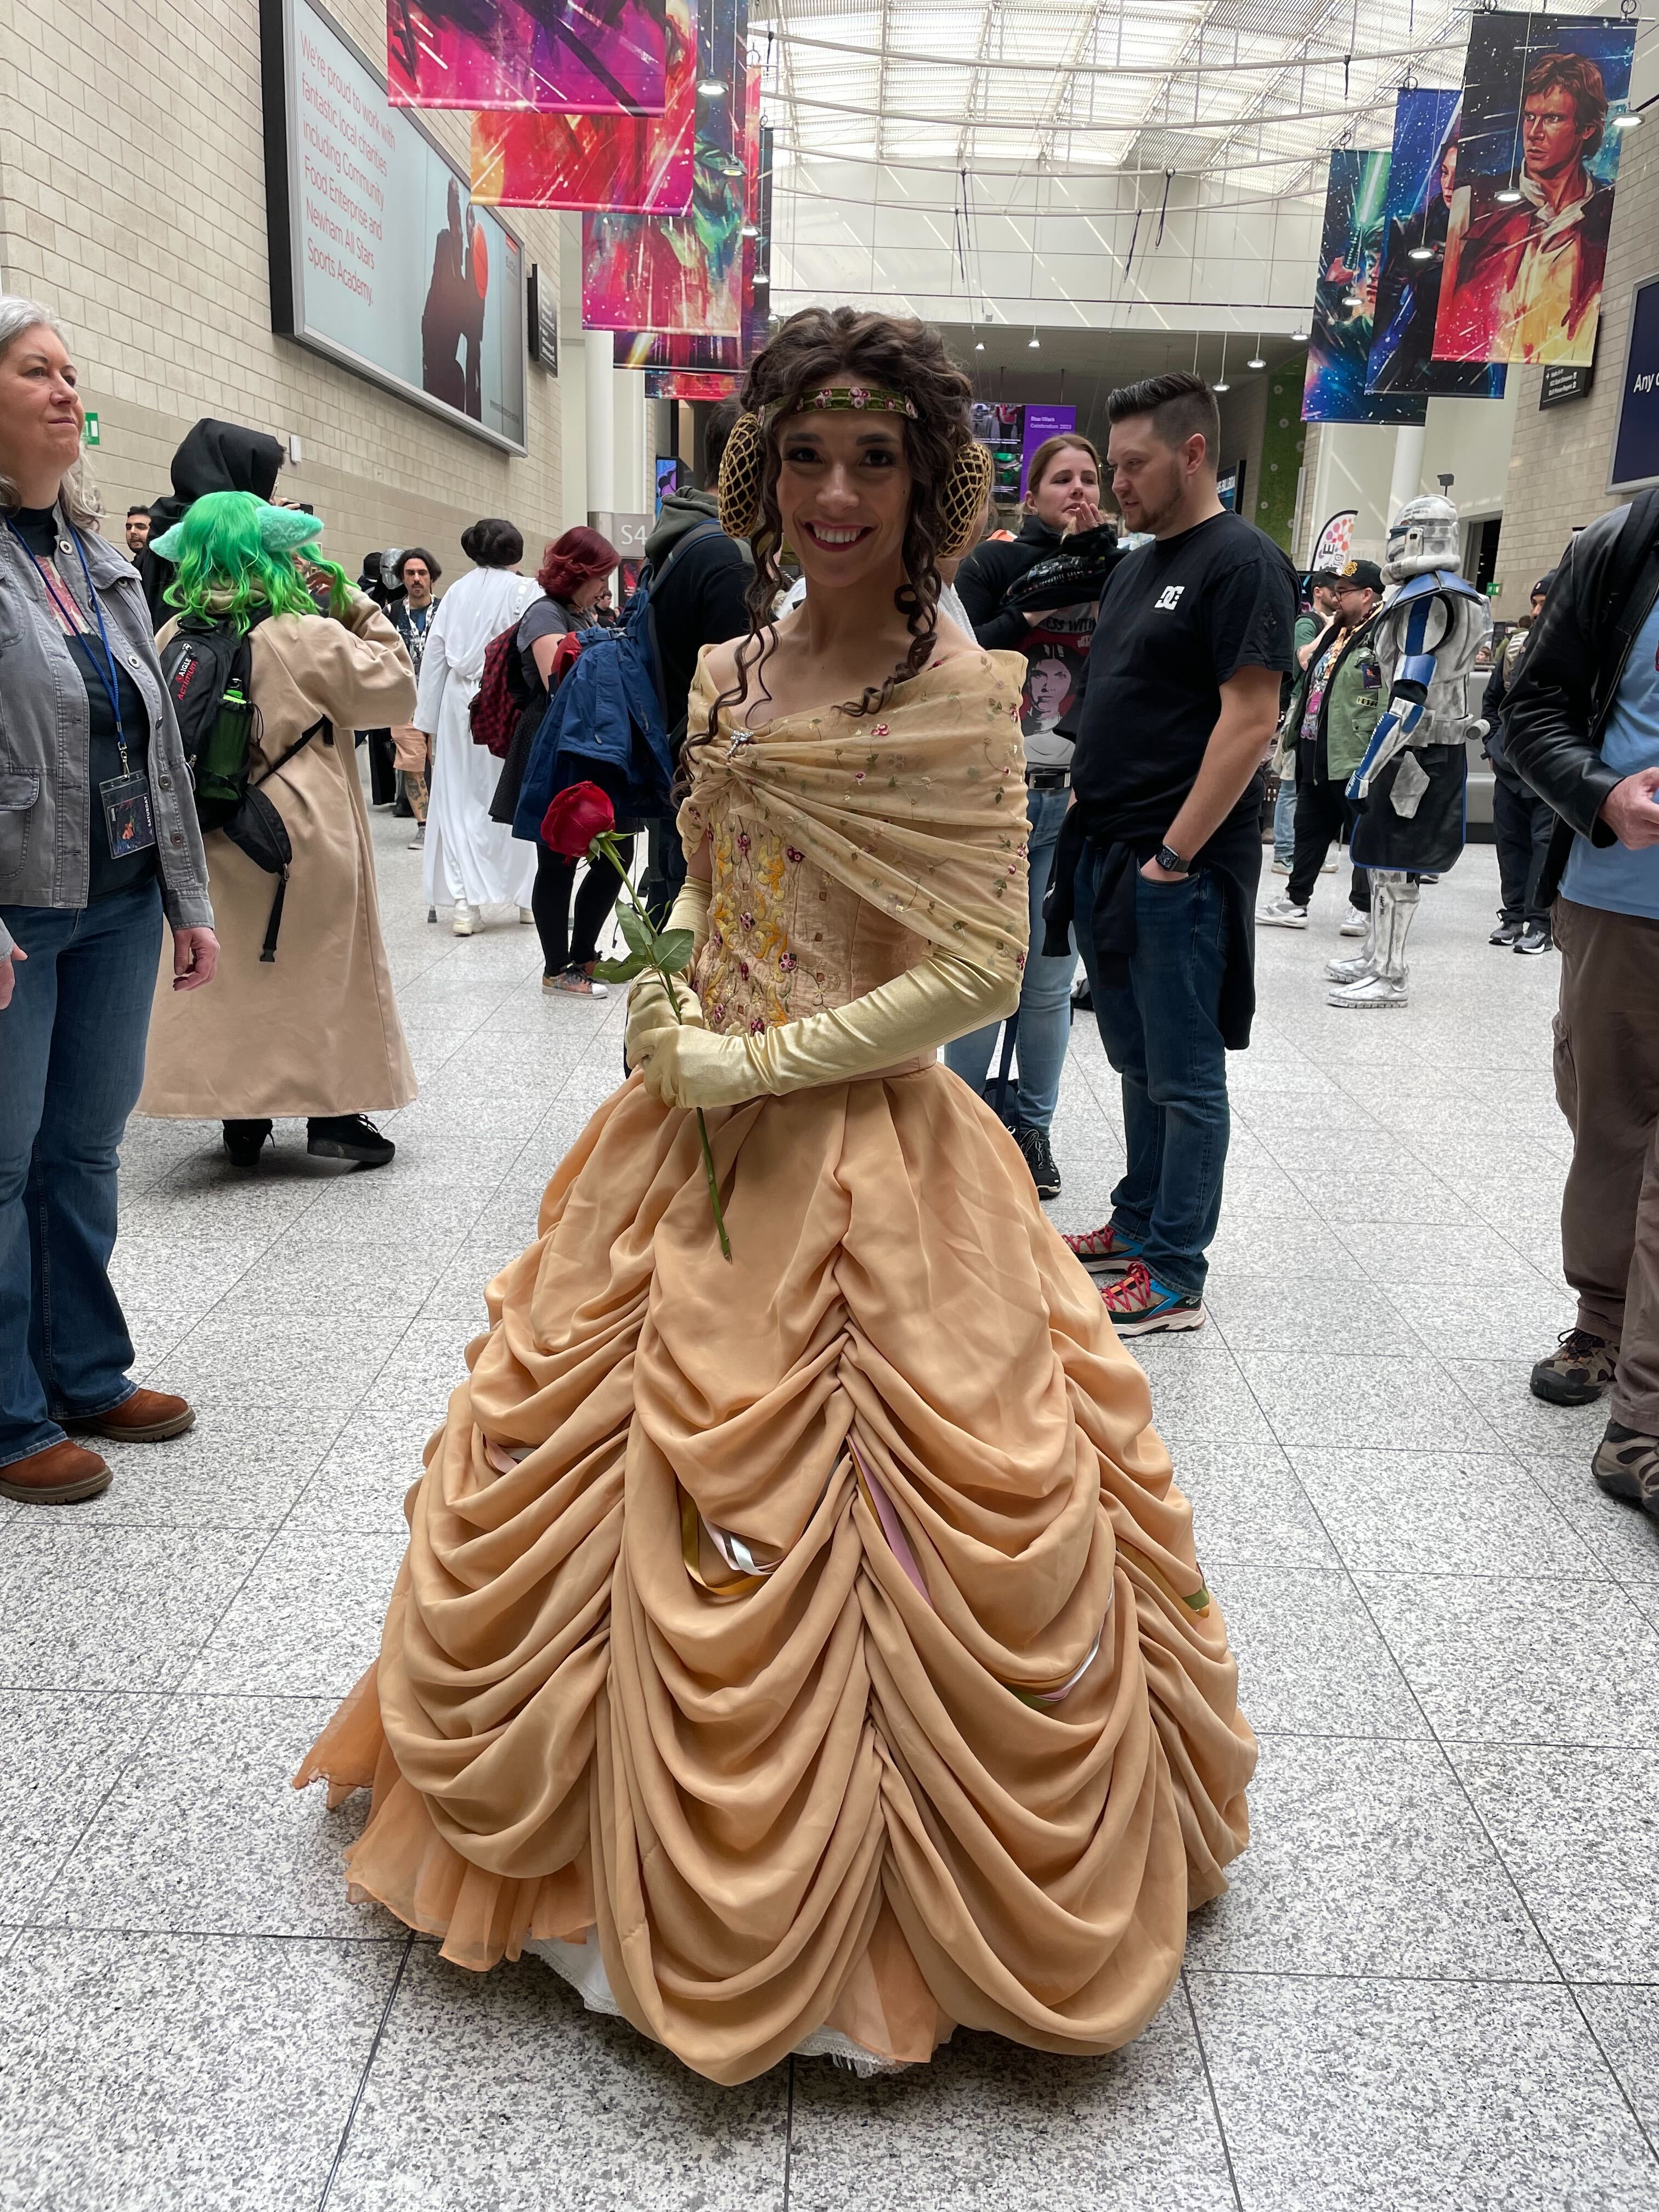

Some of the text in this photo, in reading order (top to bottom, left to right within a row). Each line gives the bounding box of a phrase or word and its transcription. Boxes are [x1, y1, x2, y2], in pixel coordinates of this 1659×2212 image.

[301, 30, 396, 153] We're proud to work with
[302, 72, 387, 177] fantastic local charities
[303, 113, 385, 212] including Community
[304, 155, 382, 242] Food Enterprise and
[306, 195, 375, 270] Newham All Stars
[307, 237, 374, 307] Sports Academy.
[1633, 373, 1655, 393] Any
[620, 524, 648, 546] S4
[178, 658, 192, 677] AIGLE
[144, 795, 152, 827] SATURDAY
